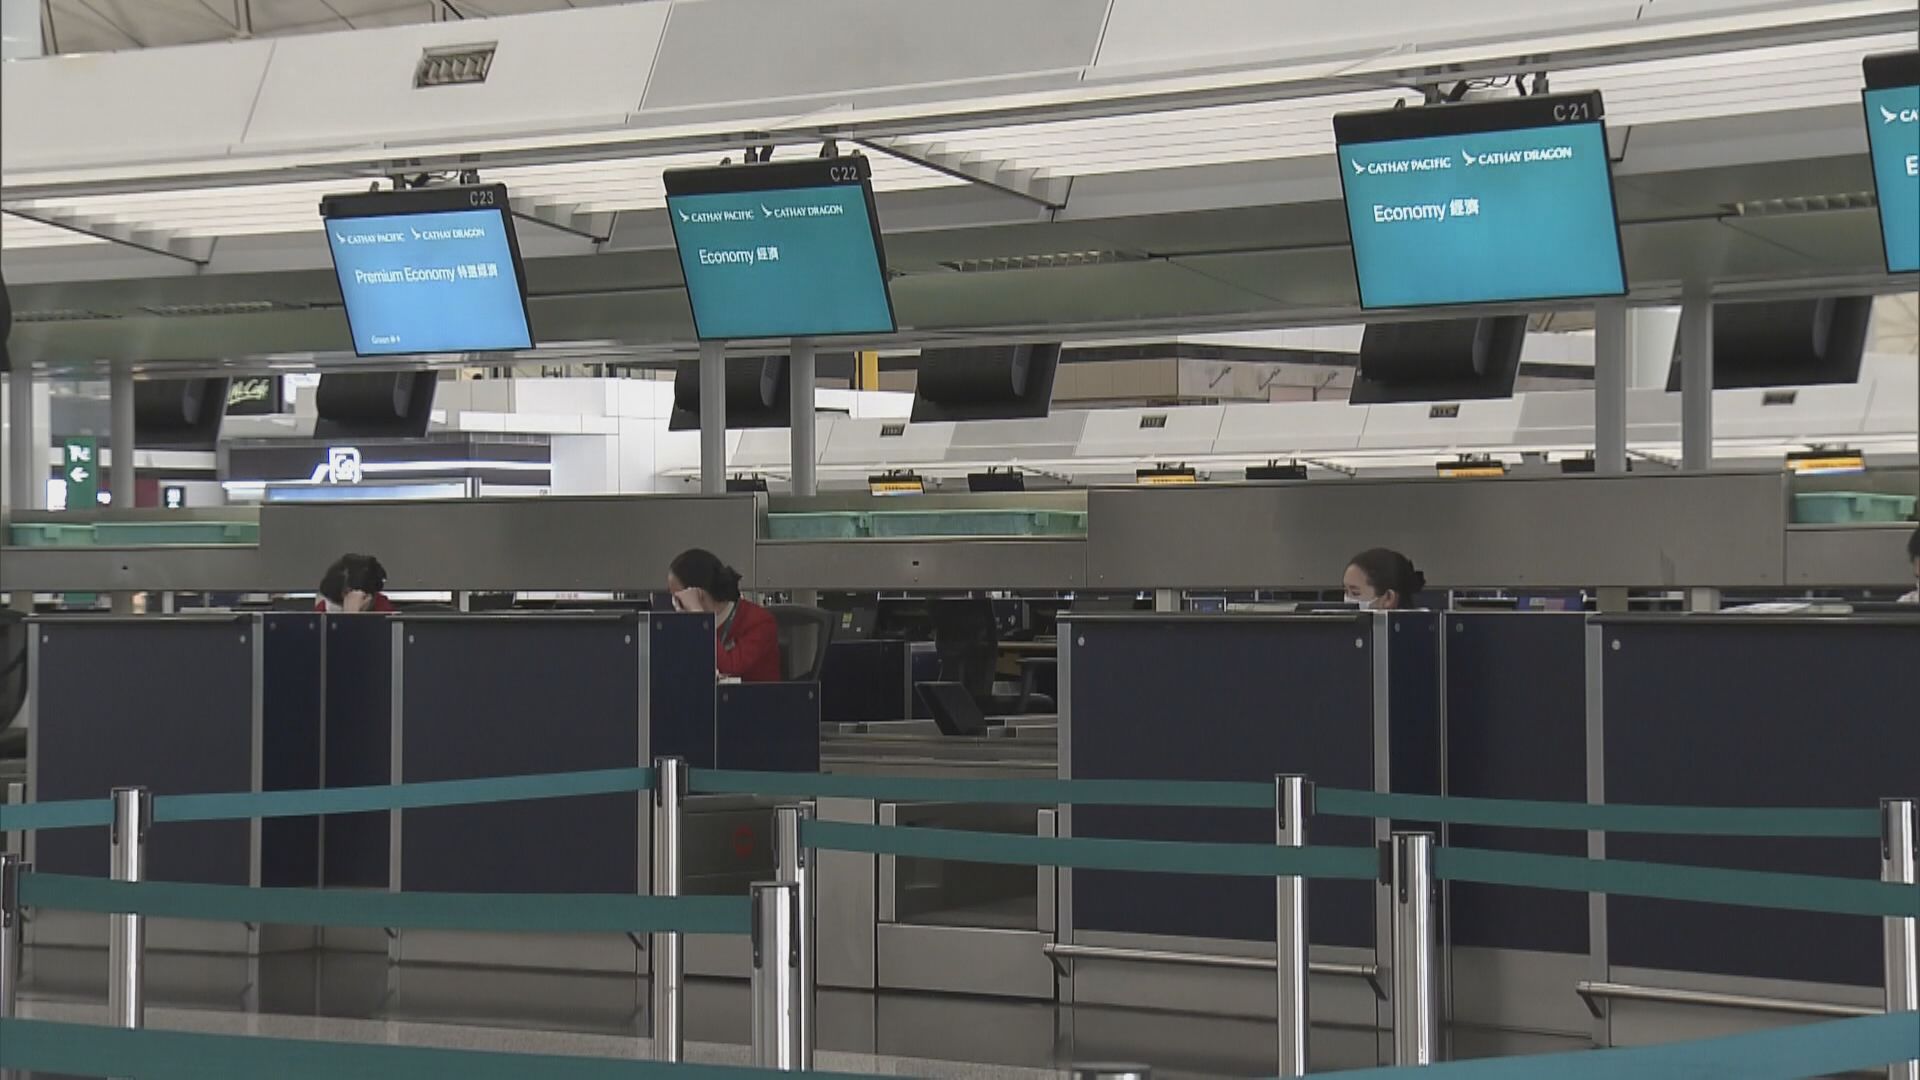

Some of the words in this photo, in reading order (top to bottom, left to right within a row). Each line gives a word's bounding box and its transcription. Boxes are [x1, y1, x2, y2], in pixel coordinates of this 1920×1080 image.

[1477, 150, 1523, 166] CATHAY
[1523, 146, 1573, 162] DRAGON
[1367, 160, 1410, 175] CATHAY
[1410, 157, 1452, 171] PACIFIC
[690, 211, 723, 223] CATHAY
[723, 209, 755, 221] PACIFIC
[773, 206, 807, 218] CATHAY
[807, 204, 844, 216] DRAGON
[1373, 202, 1447, 223] Economy
[347, 233, 377, 244] CATHAY
[377, 232, 406, 243] PACIFIC
[422, 229, 452, 241] CATHAY
[452, 227, 486, 238] DRAGON
[699, 249, 754, 265] Economy
[356, 269, 403, 284] Premium
[404, 266, 456, 283] Economy
